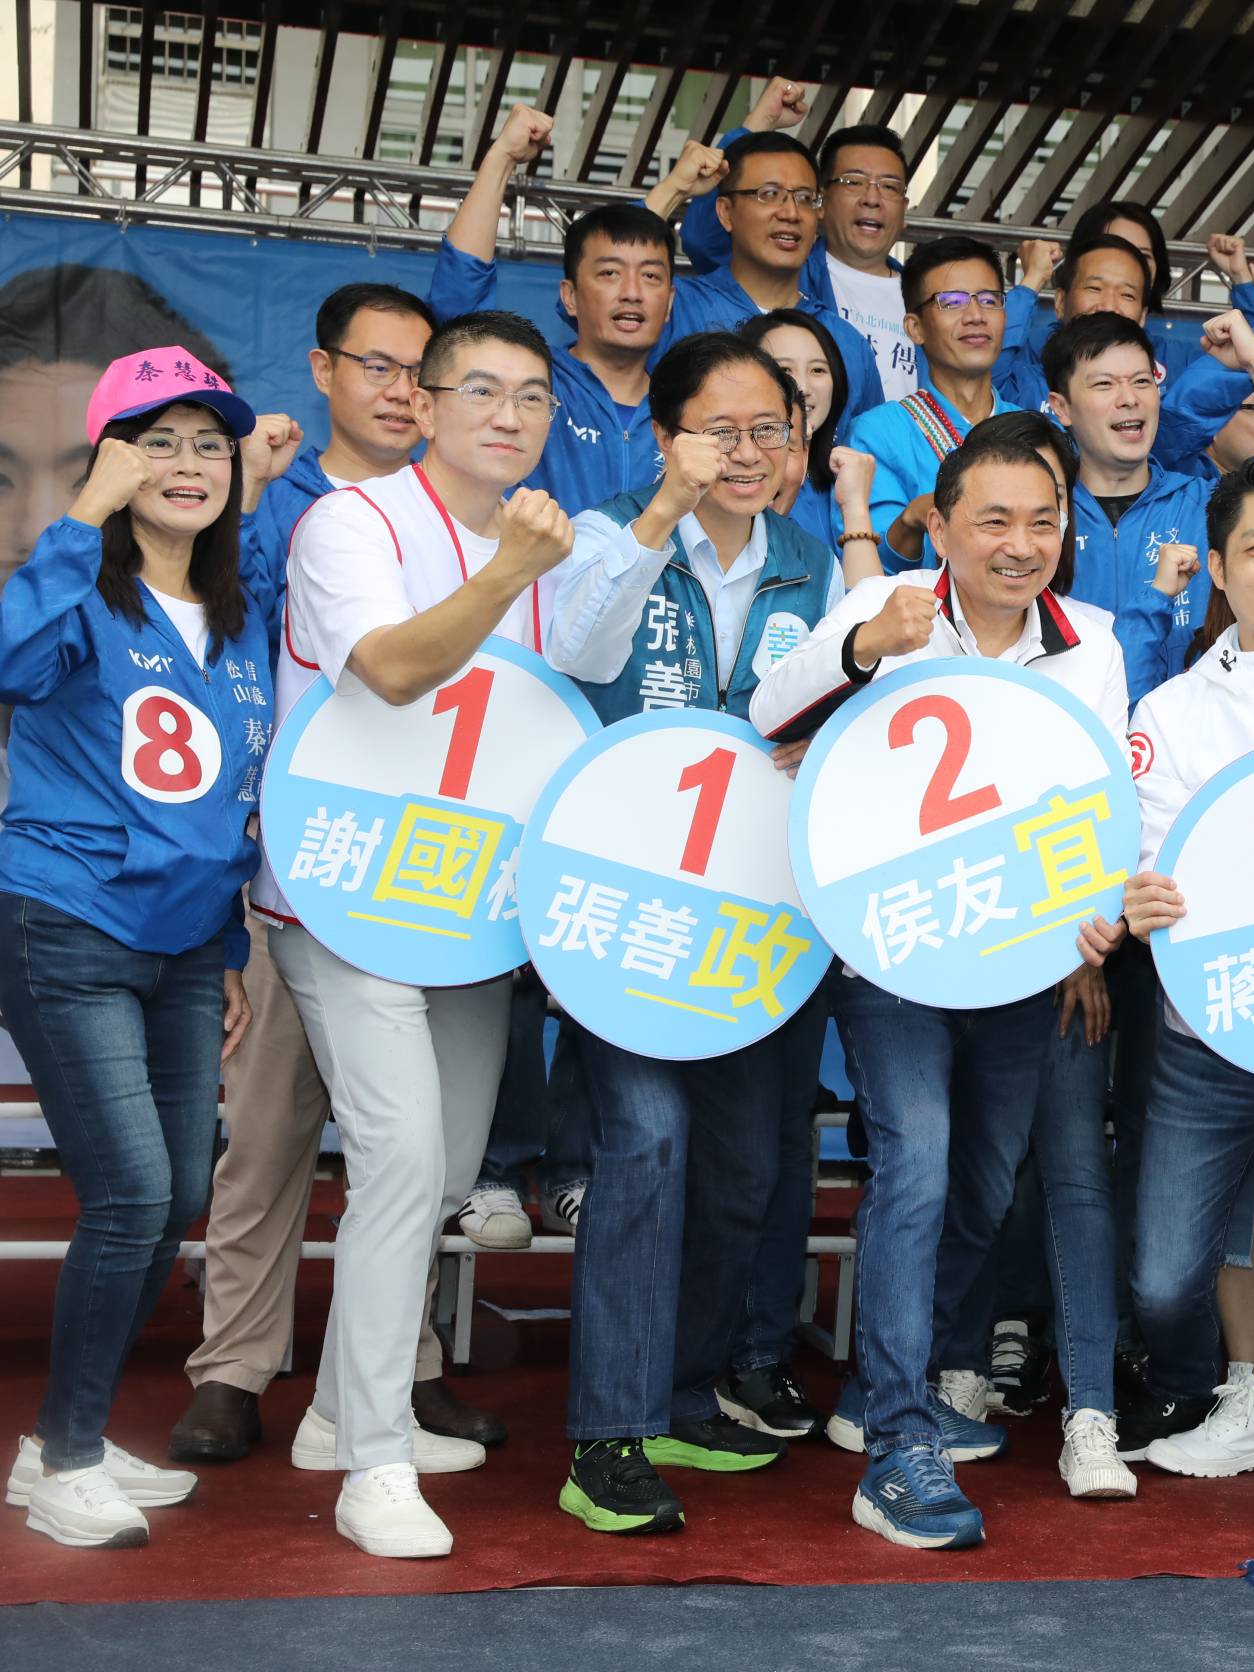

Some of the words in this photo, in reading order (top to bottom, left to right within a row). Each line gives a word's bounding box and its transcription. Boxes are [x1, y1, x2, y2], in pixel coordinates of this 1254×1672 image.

[135, 360, 220, 390] 秦慧珠
[128, 649, 174, 673] KMT
[639, 594, 688, 712] 張善
[133, 696, 202, 792] 8
[432, 666, 495, 800] 1
[888, 694, 1002, 836] 2
[677, 747, 737, 876] 1
[861, 790, 1129, 970] 侯友宜
[538, 873, 812, 1019] 張善政
